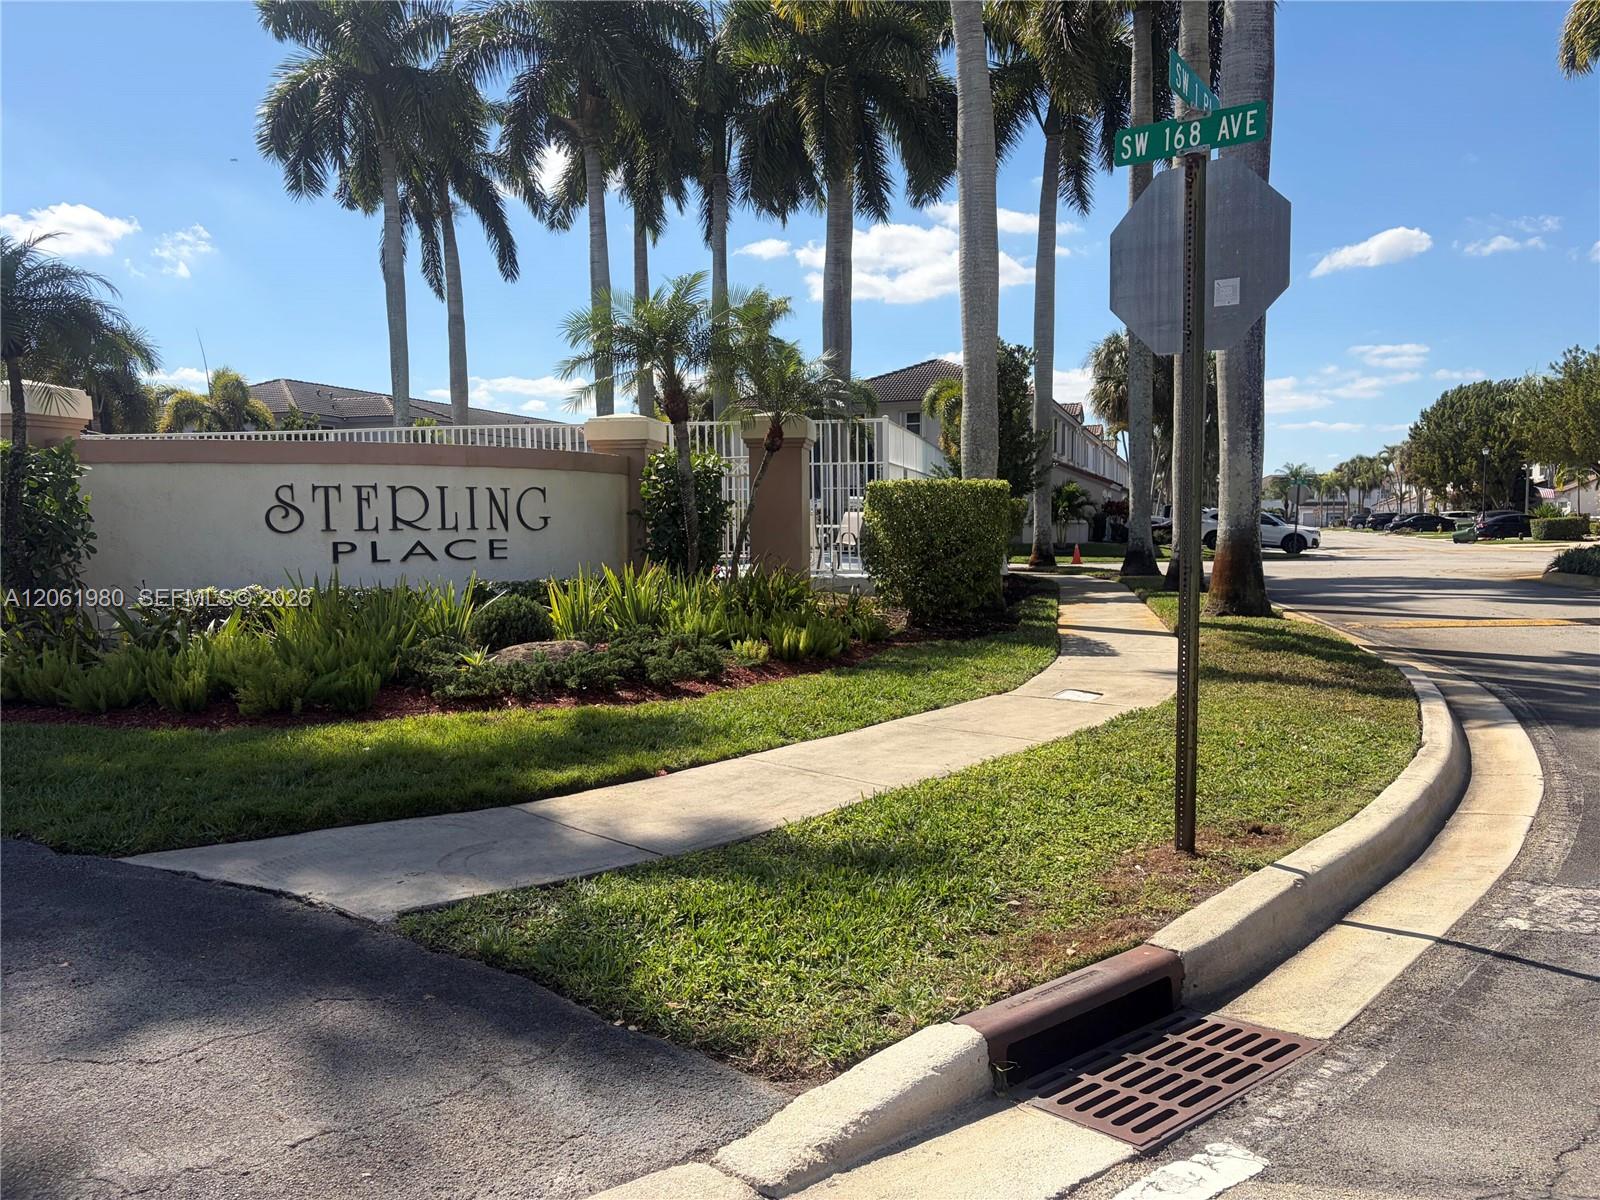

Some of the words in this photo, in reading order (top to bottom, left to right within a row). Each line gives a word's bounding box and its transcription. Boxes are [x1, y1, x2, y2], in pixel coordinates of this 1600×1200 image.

[1176, 62, 1189, 96] SW
[1121, 131, 1149, 160] SW
[1164, 121, 1201, 151] 168
[1217, 110, 1258, 142] AVE
[265, 482, 551, 534] STERLING
[332, 538, 508, 564] PLACE
